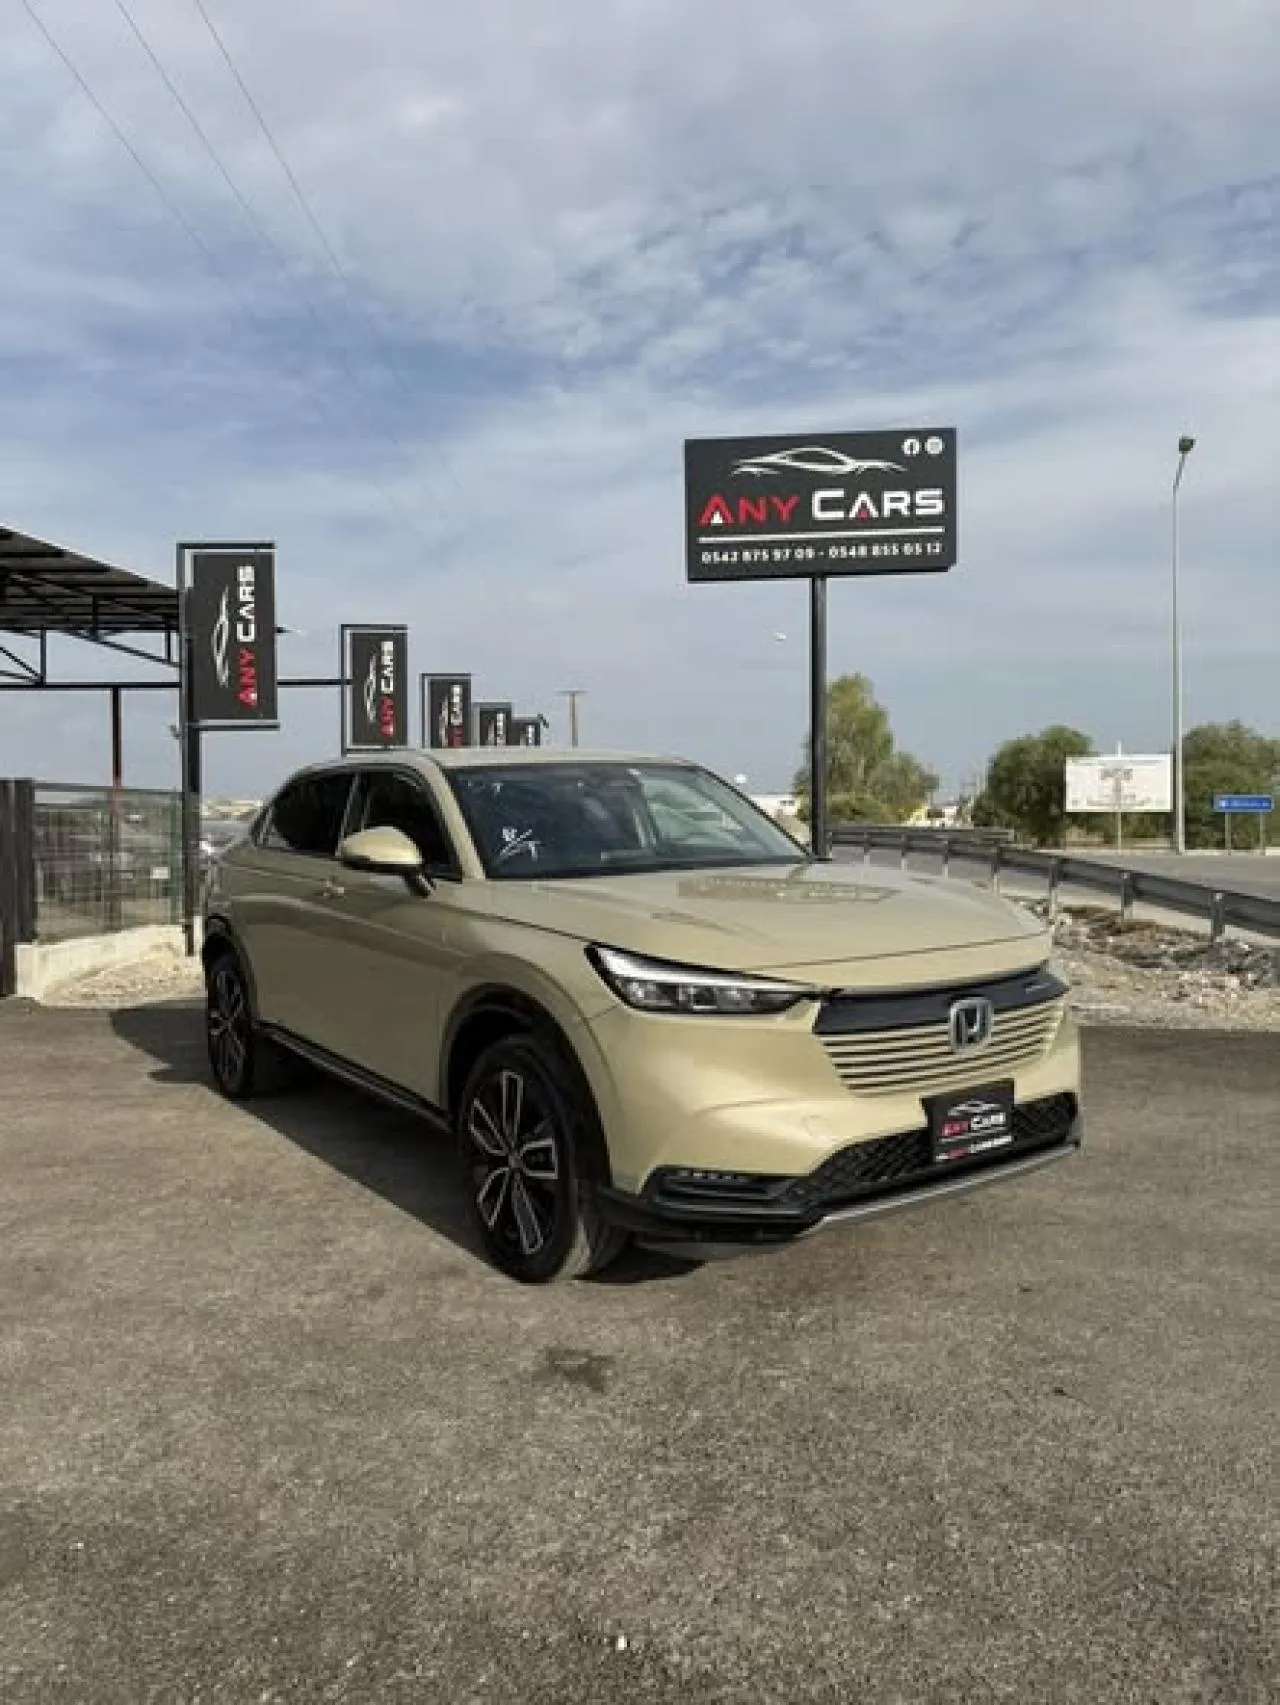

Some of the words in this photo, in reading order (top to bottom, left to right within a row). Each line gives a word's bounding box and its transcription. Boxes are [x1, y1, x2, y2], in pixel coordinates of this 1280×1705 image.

[698, 492, 799, 526] ANY
[811, 488, 943, 520] CARS
[237, 566, 255, 643] CARS
